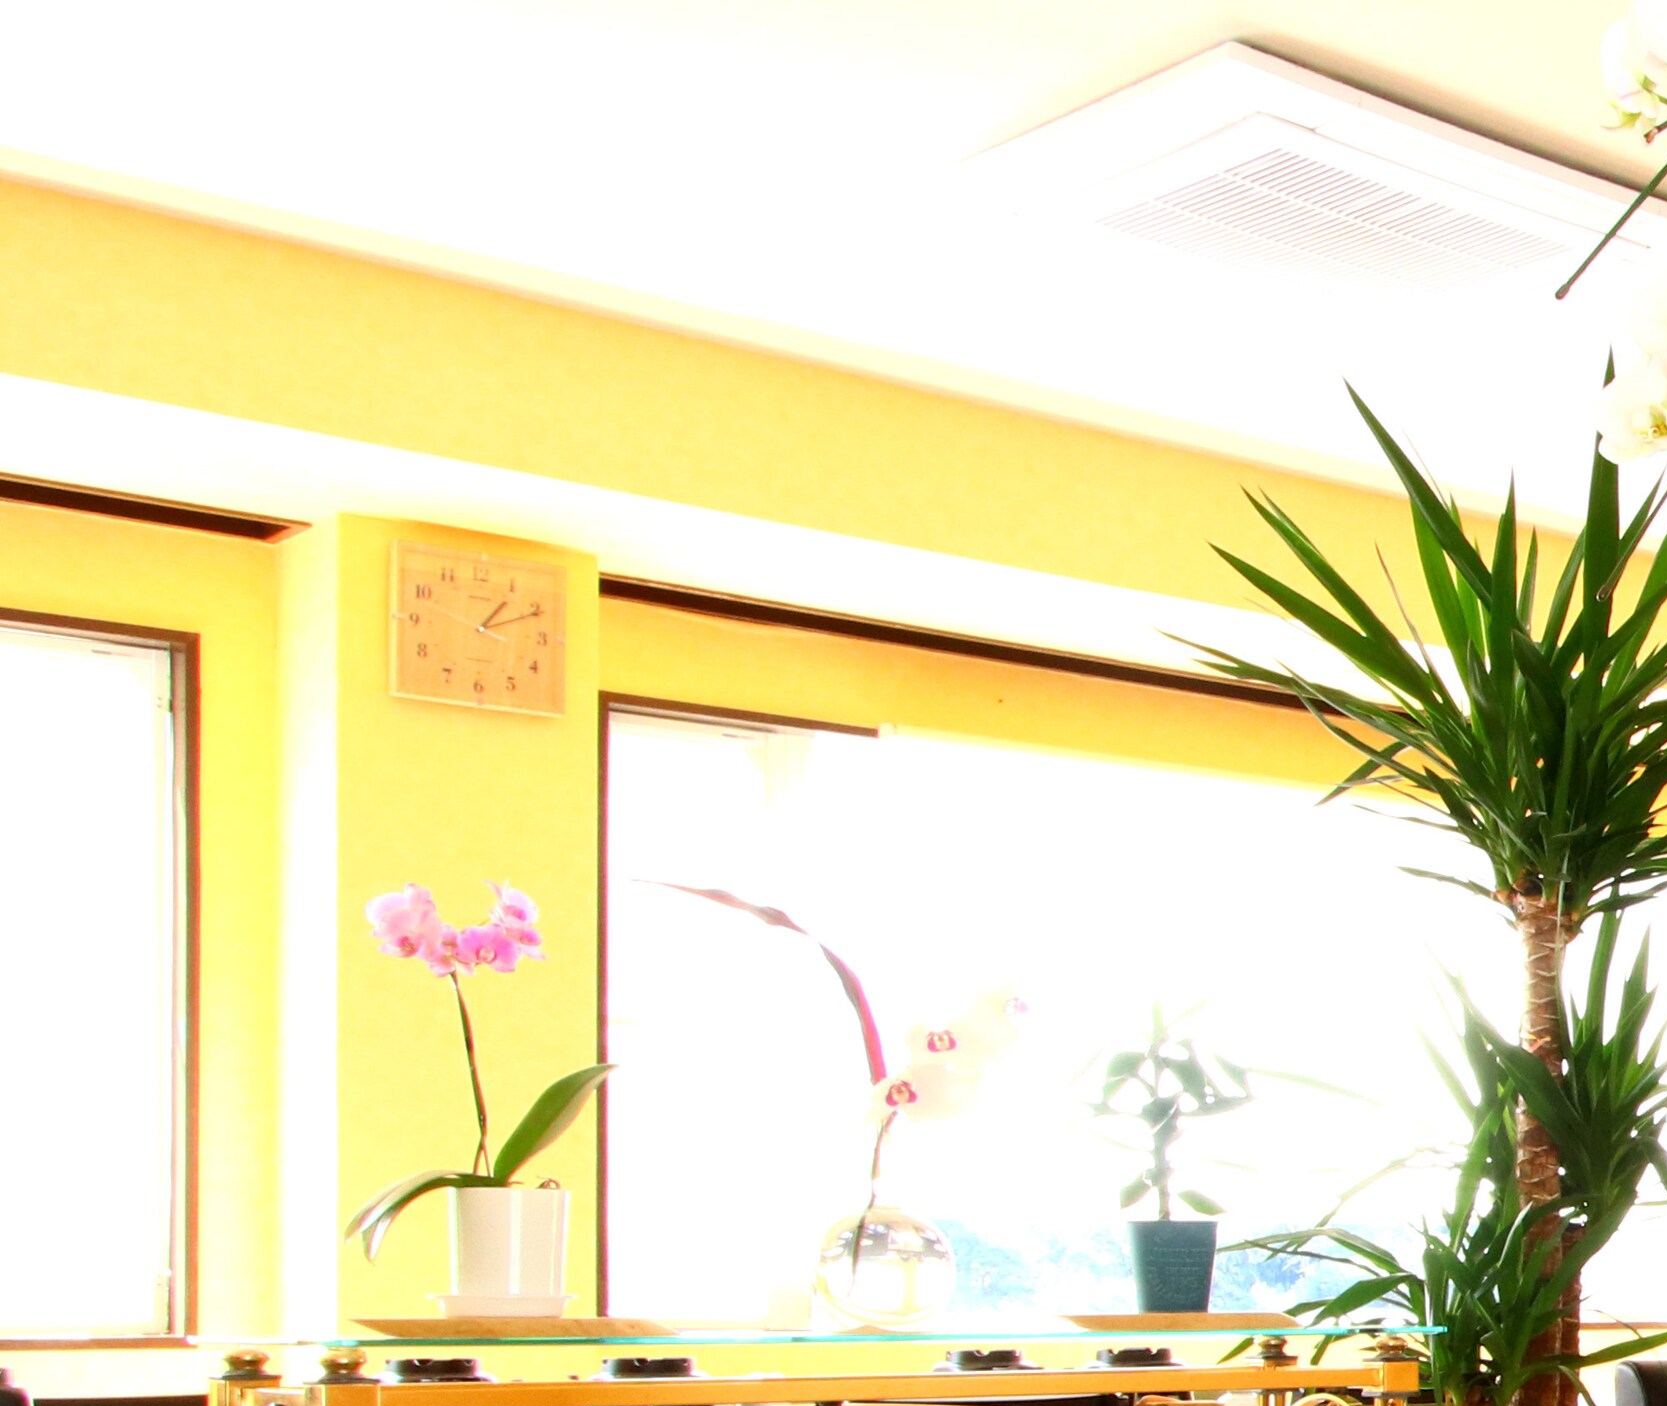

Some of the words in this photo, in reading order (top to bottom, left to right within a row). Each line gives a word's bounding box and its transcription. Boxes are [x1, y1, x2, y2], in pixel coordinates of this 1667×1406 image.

[415, 584, 432, 600] 10
[409, 612, 420, 626] 9
[536, 631, 548, 647] 3
[416, 643, 428, 658] 8
[528, 660, 539, 674] 4
[442, 667, 452, 683] 7
[473, 680, 484, 693] 6
[505, 676, 516, 692] 5
